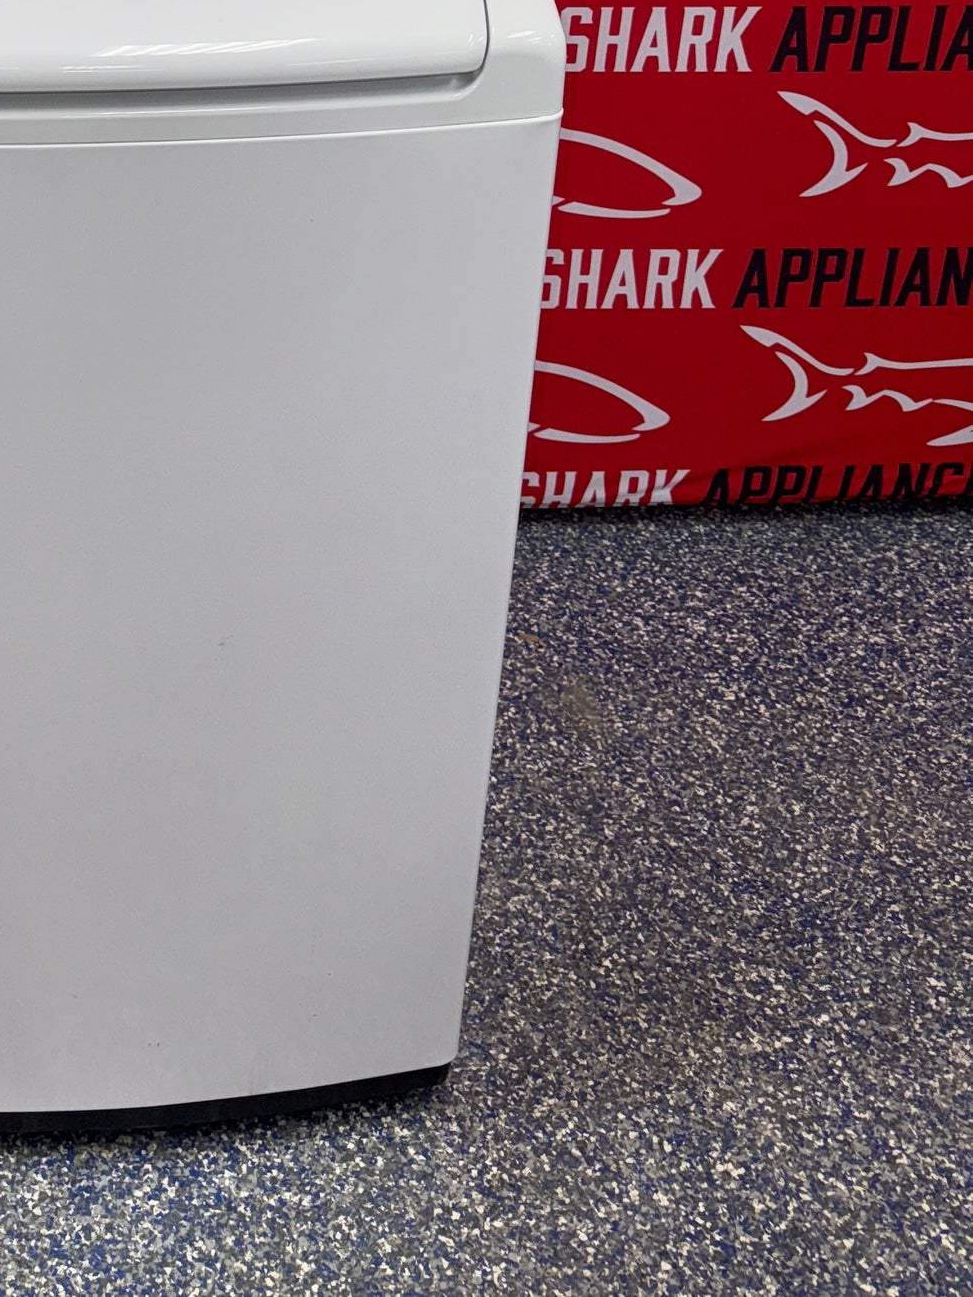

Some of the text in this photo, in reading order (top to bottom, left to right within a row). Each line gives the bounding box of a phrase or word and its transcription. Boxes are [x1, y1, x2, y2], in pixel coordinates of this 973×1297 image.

[565, 5, 973, 72] SHARK APPLIA
[540, 246, 973, 309] SHARK APPLIAN
